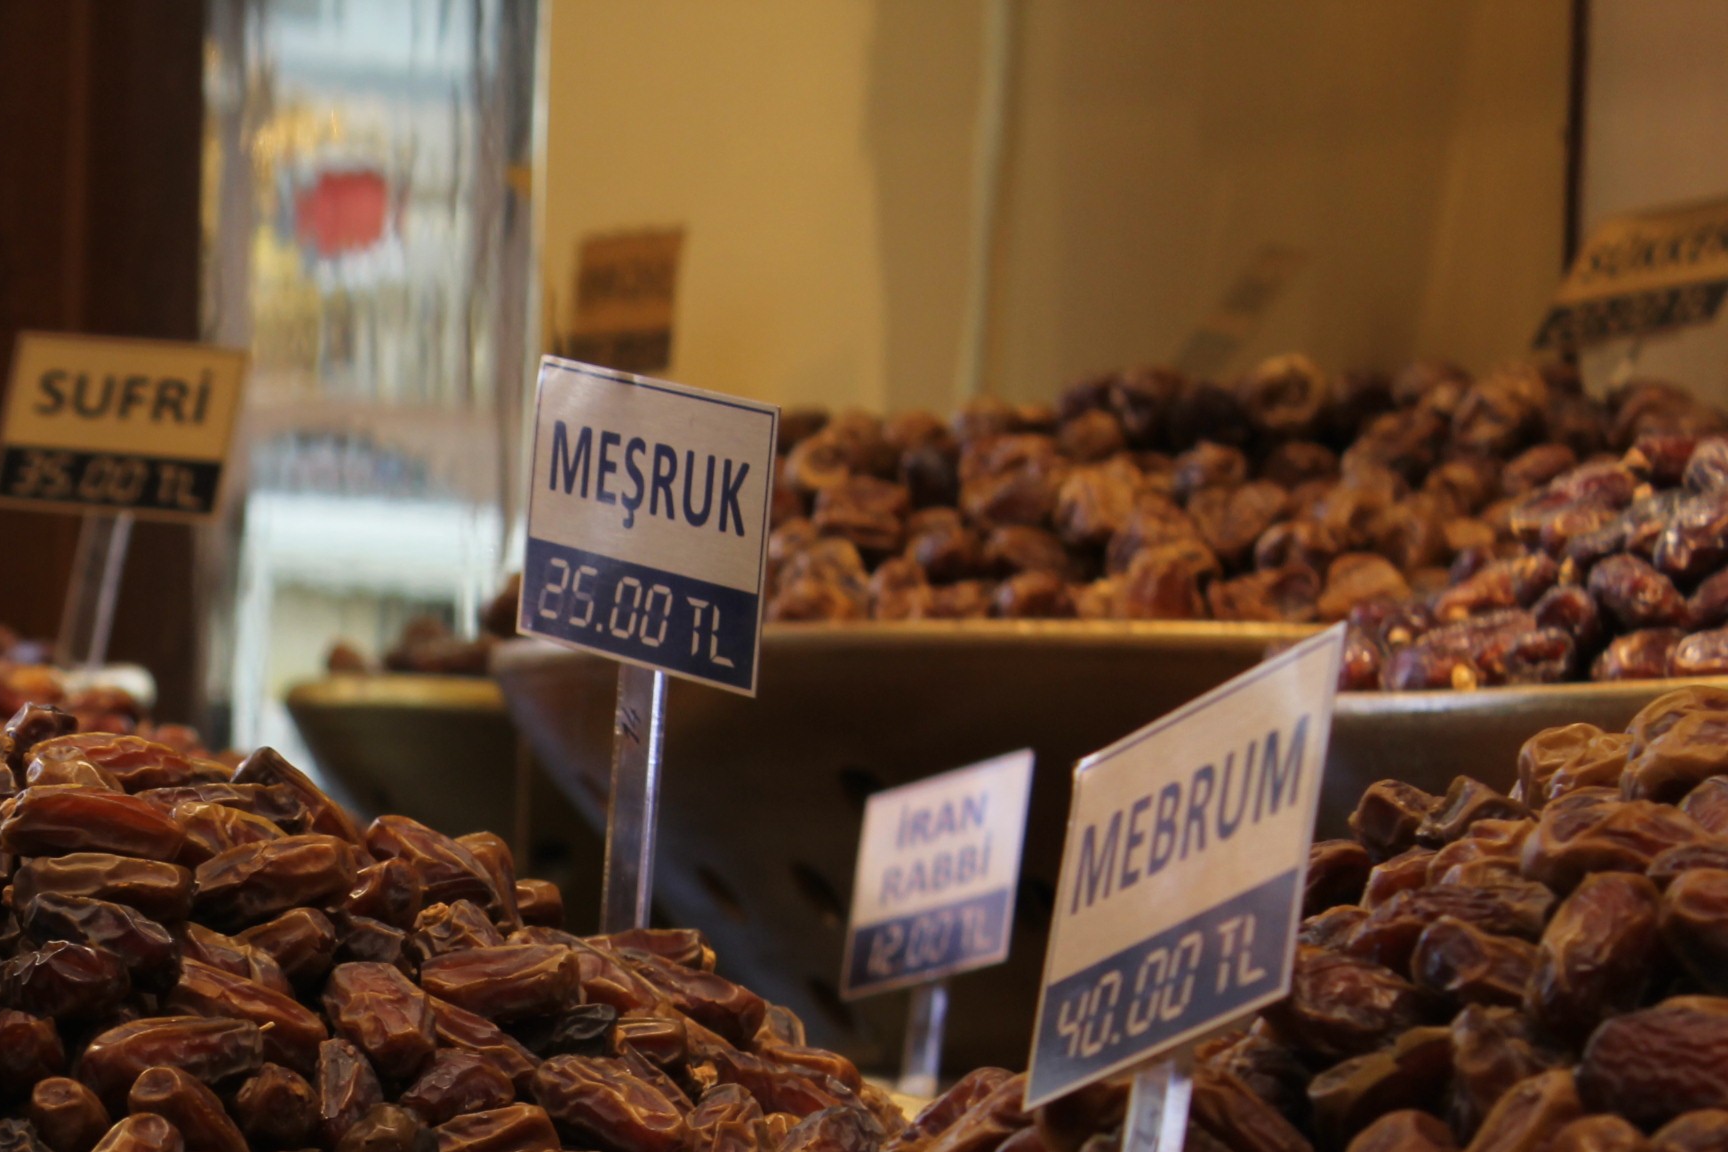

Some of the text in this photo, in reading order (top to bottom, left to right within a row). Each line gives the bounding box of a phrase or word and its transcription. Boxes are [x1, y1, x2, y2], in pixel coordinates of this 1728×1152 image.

[33, 368, 213, 425] SUFRİ
[156, 465, 204, 508] TL
[549, 420, 751, 537] MEŞRUK
[537, 556, 736, 669] 25.00 TL
[896, 788, 990, 851] İRAN
[1070, 713, 1312, 916] MEBRUM
[878, 829, 994, 906] RABBİ
[959, 903, 994, 953] TL
[1056, 912, 1266, 1059] 40.00 TL
